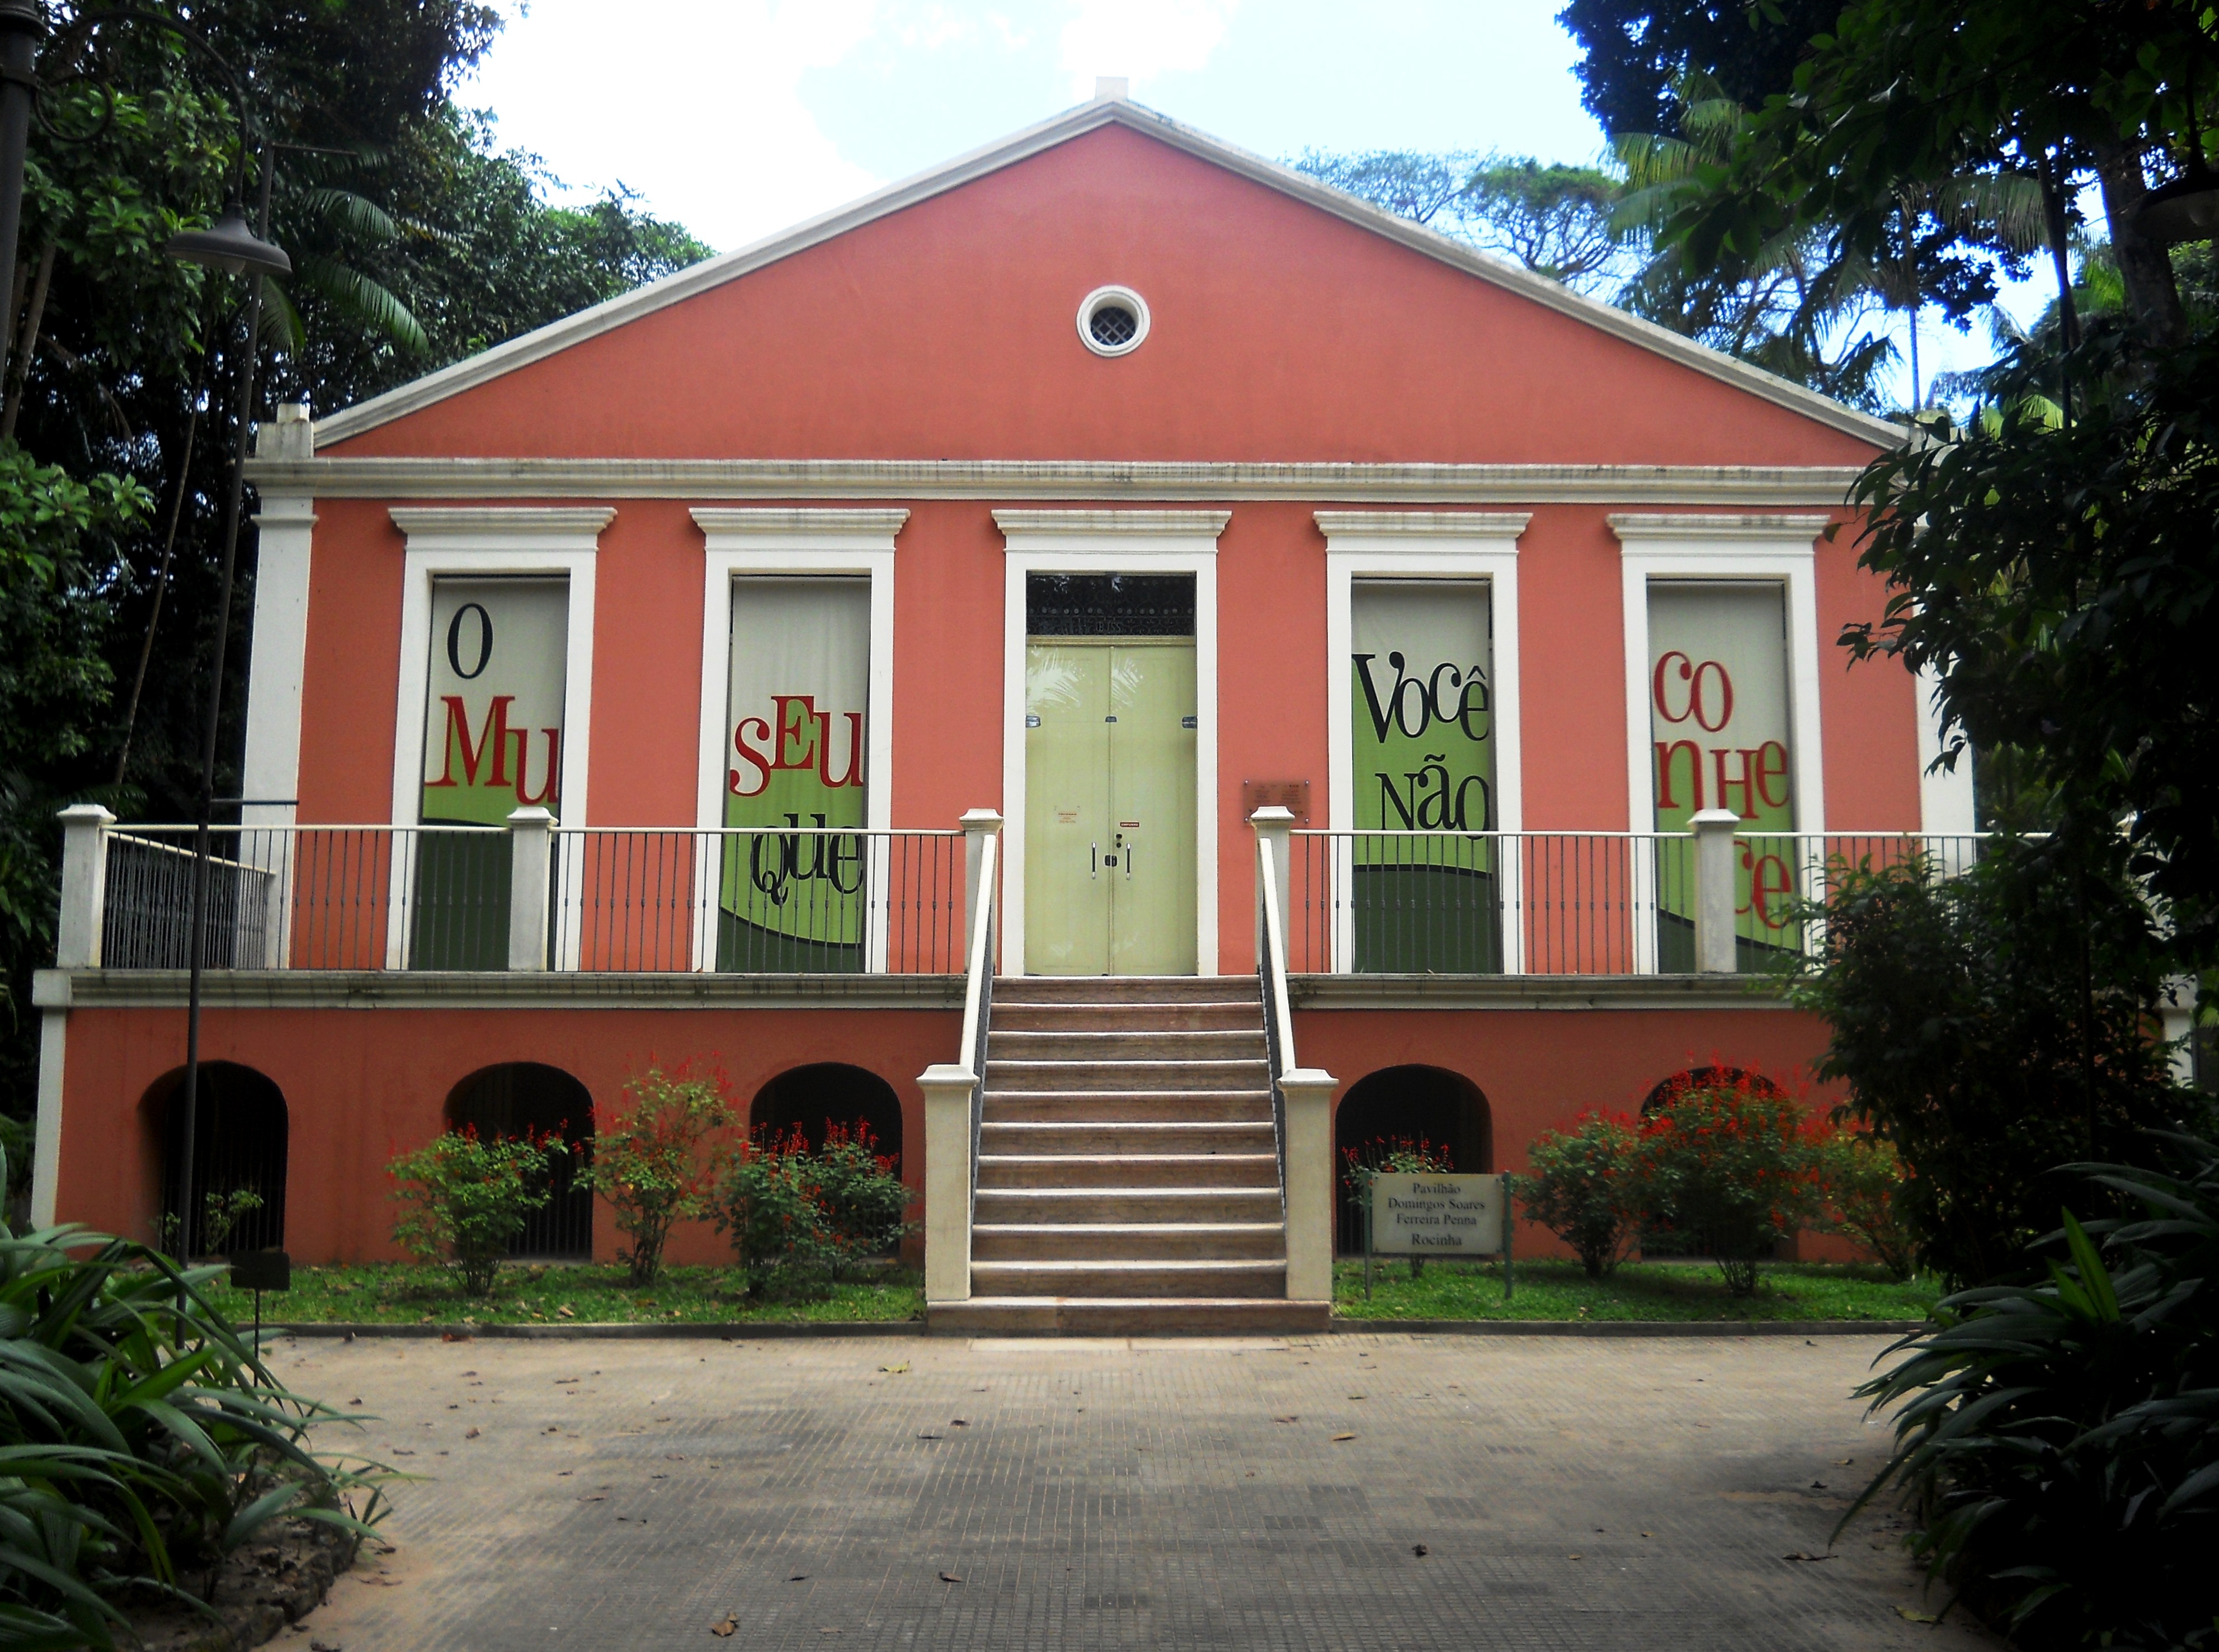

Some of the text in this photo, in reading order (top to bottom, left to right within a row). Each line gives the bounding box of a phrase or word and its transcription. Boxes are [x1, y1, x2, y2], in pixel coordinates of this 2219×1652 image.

[447, 602, 493, 679] O
[1351, 651, 1489, 743] Você
[424, 696, 559, 805] Mu
[1412, 1182, 1461, 1194] Pavilhão
[1388, 1197, 1486, 1211] Domingos Soares
[1396, 1213, 1477, 1225] Ferreira Penna
[1411, 1233, 1463, 1245] Rocinha
